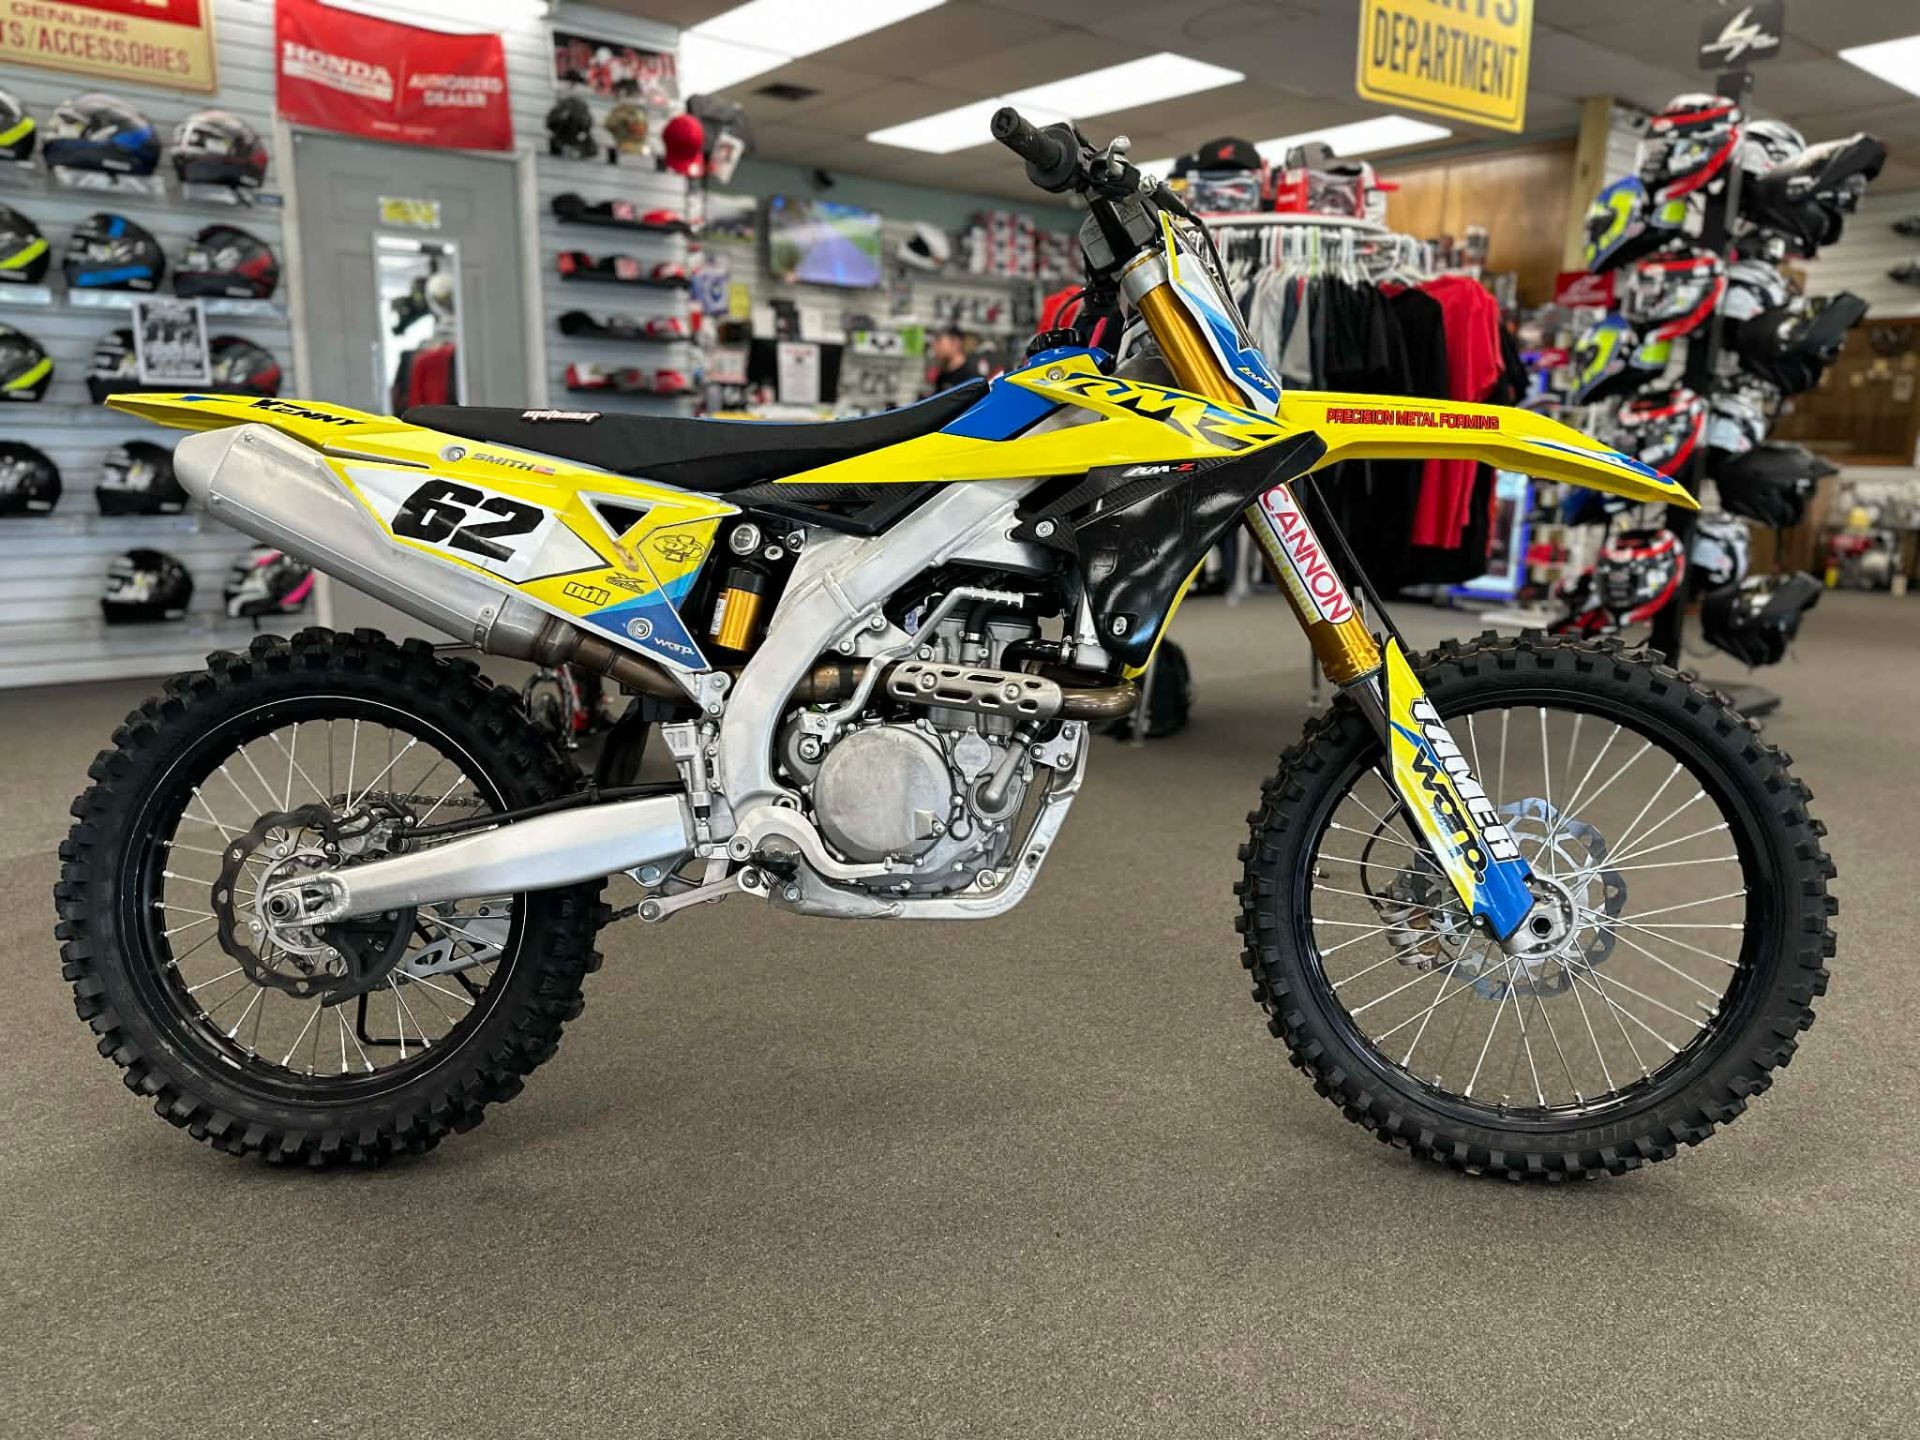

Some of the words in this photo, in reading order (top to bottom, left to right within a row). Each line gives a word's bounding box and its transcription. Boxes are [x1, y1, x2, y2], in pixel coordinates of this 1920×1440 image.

[11, 1, 128, 33] GENUINE
[283, 41, 392, 85] HONDA
[1373, 8, 1518, 99] DEPARTMENT
[407, 73, 503, 93] AUTHORIZED
[423, 90, 487, 108] DEALER
[1326, 408, 1394, 426] PRECISION
[1395, 410, 1438, 428] METAL
[1439, 412, 1500, 430] FORMING
[470, 452, 535, 472] SMITH
[391, 479, 544, 562] 62
[1262, 486, 1351, 621] CANNON
[563, 582, 611, 606] odi
[1410, 694, 1521, 862] TAMER
